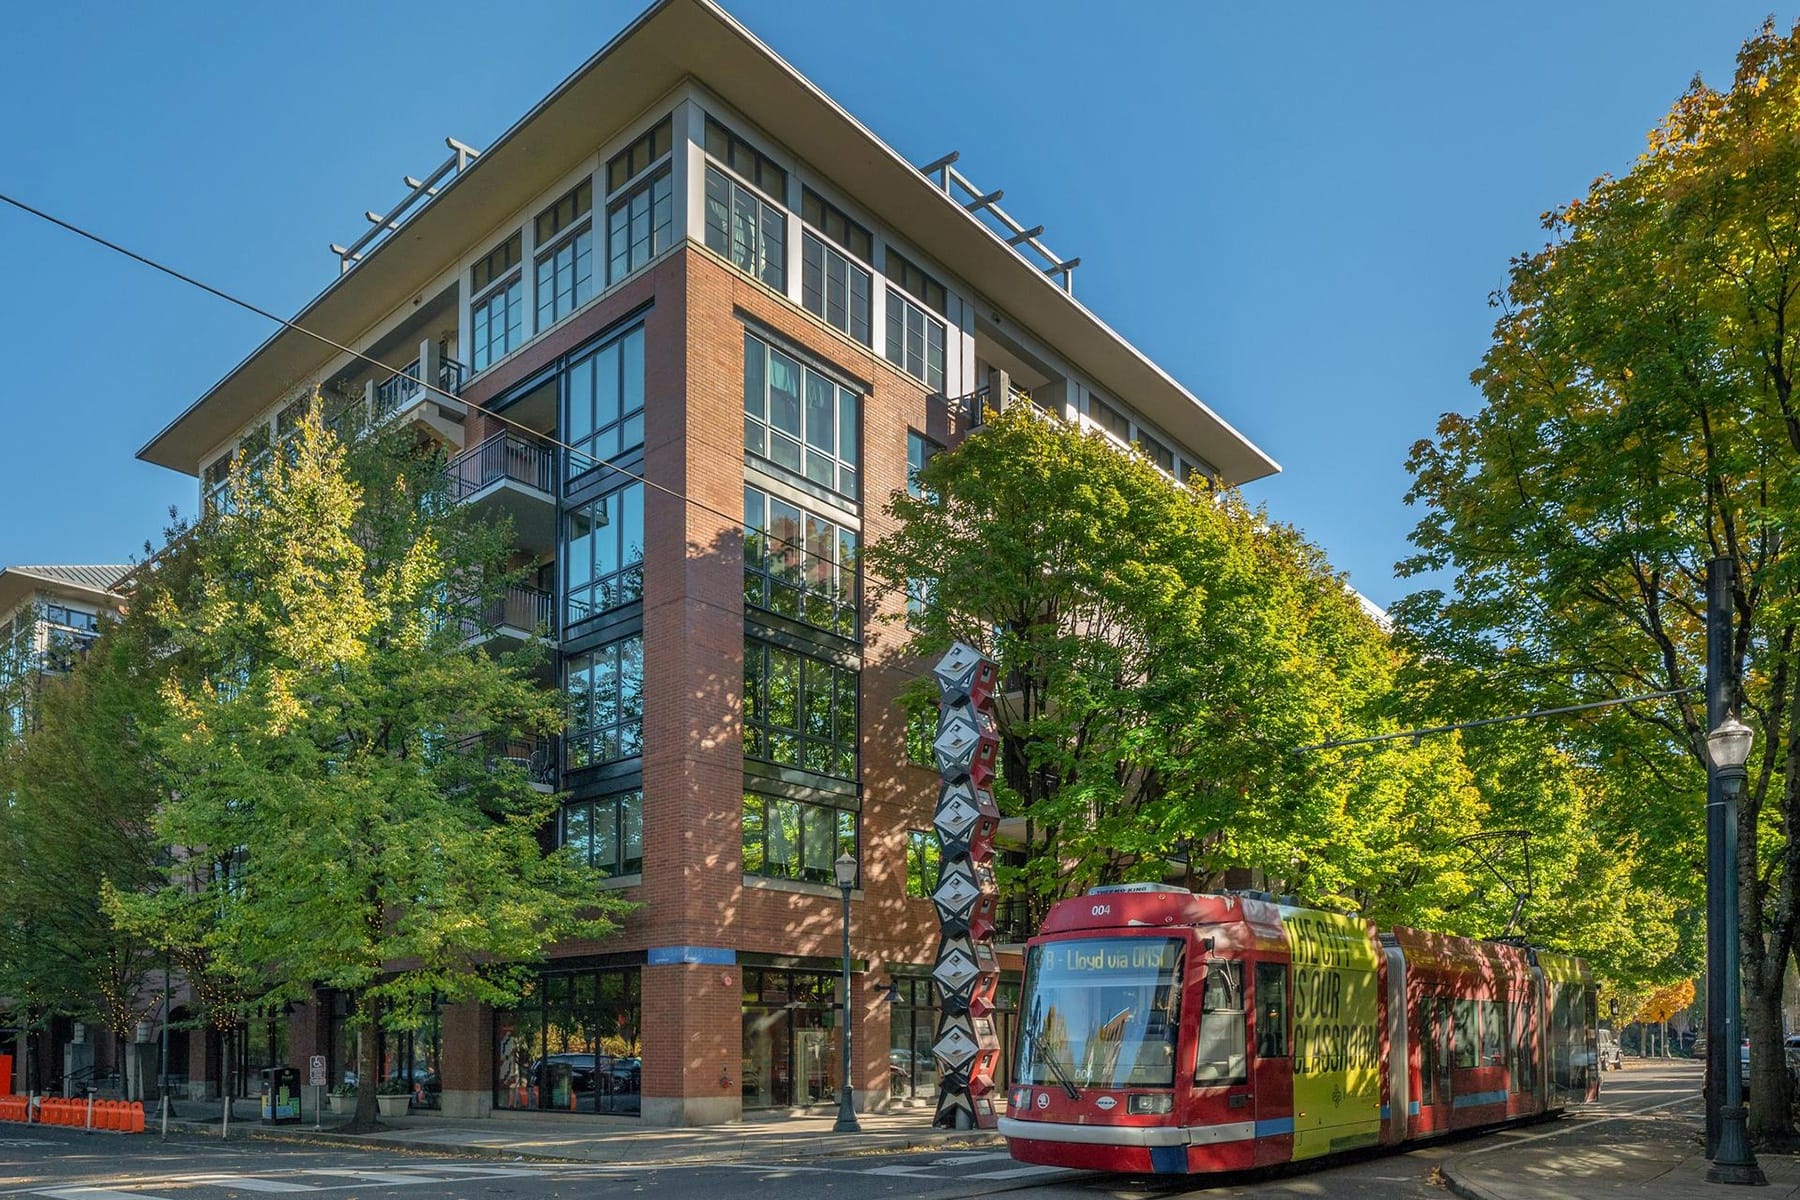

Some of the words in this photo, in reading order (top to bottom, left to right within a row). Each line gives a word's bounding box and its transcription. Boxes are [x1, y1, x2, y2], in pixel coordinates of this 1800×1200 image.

[1091, 905, 1111, 916] 004
[1067, 949, 1104, 971] Lloyd
[1107, 951, 1129, 968] via
[1283, 917, 1318, 964] THE
[1316, 920, 1350, 967] CITY
[1293, 969, 1307, 1019] IS
[1310, 970, 1341, 1019] OUR
[1294, 1022, 1379, 1075] CLASSROOM
